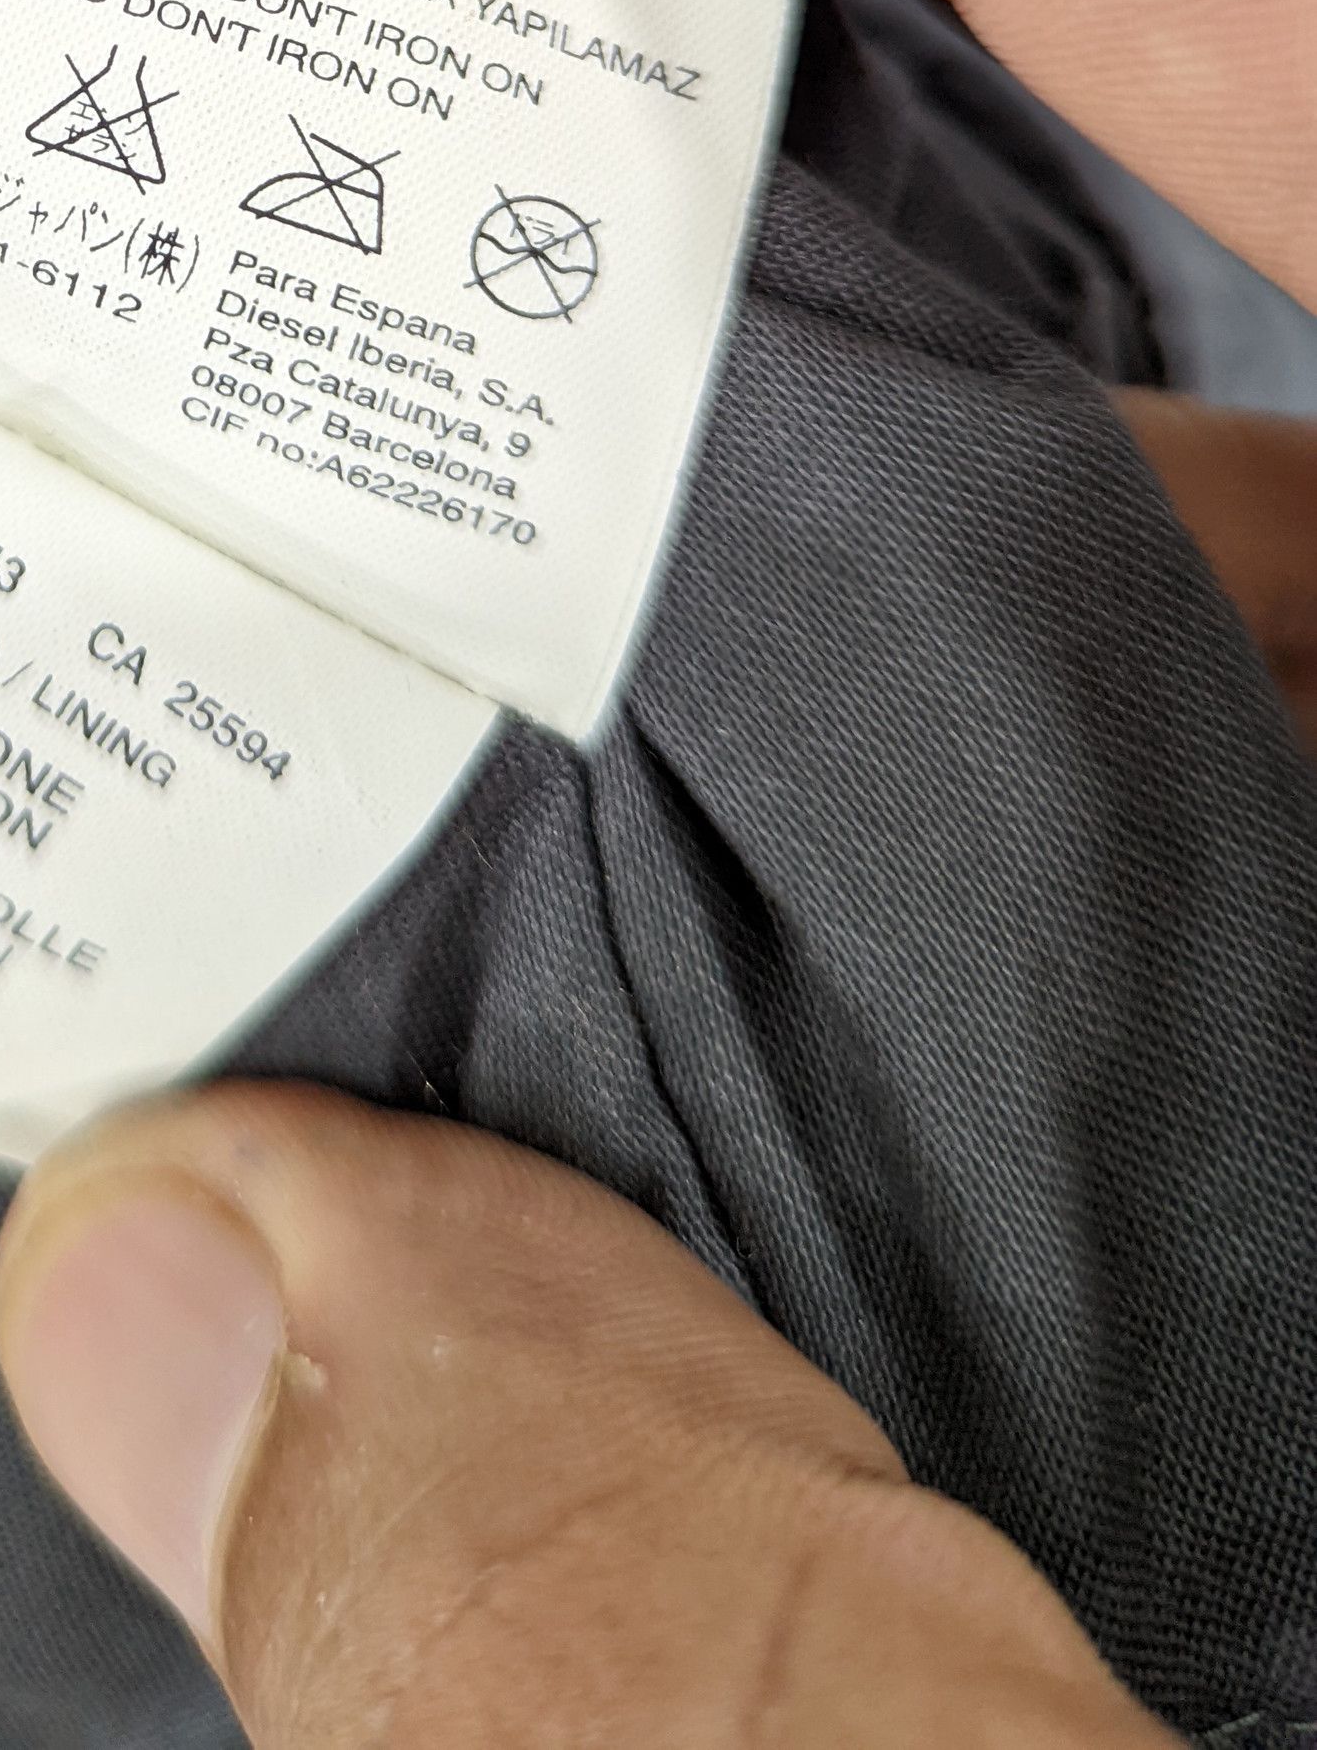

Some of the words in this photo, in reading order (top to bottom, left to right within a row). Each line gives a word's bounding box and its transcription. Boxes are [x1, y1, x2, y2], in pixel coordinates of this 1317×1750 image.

[266, 33, 378, 94] IRON
[387, 76, 454, 121] ON
[363, 19, 472, 80] IRON
[481, 62, 545, 106] ON
[215, 288, 339, 352] Diesel
[348, 331, 463, 400] Iberia,
[478, 377, 555, 426] S.A.
[228, 249, 317, 302] Para
[330, 283, 478, 355] Espana
[180, 395, 249, 433] CIF
[190, 364, 314, 425] 08007
[321, 409, 518, 500] Barcelona
[202, 326, 276, 375] Pza
[287, 358, 490, 452] Catalunya,
[503, 430, 533, 459] 9
[31, 673, 178, 789] LINING
[87, 622, 149, 685] CA
[163, 680, 292, 781] 25594
